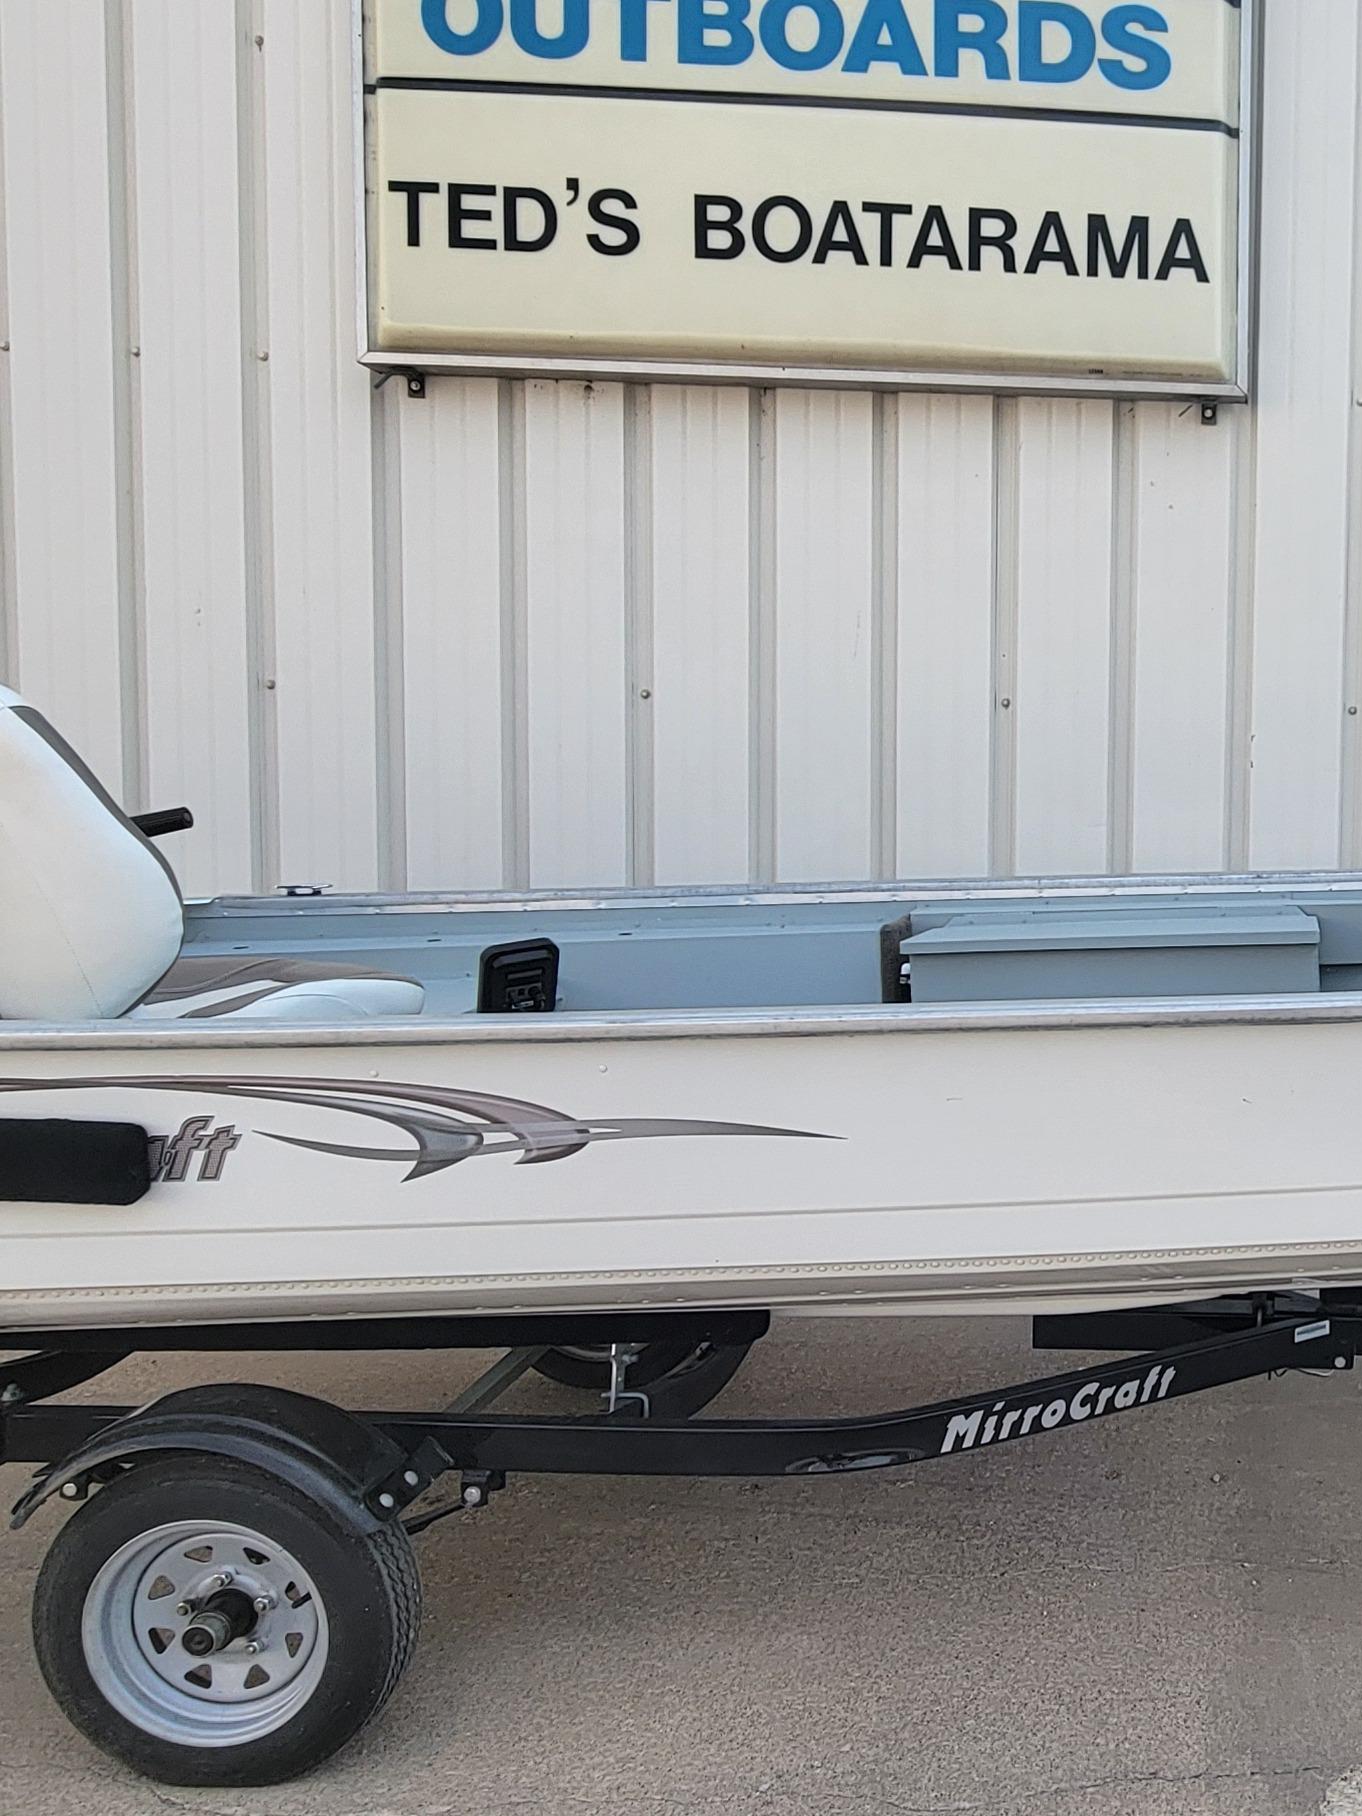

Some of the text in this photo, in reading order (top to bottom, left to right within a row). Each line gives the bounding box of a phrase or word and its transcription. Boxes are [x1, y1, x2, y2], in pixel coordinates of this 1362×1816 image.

[420, 0, 1172, 91] OUTBOARDS
[388, 177, 1211, 284] TED'S BOATARAMA
[940, 1364, 1177, 1455] MirroCraft
